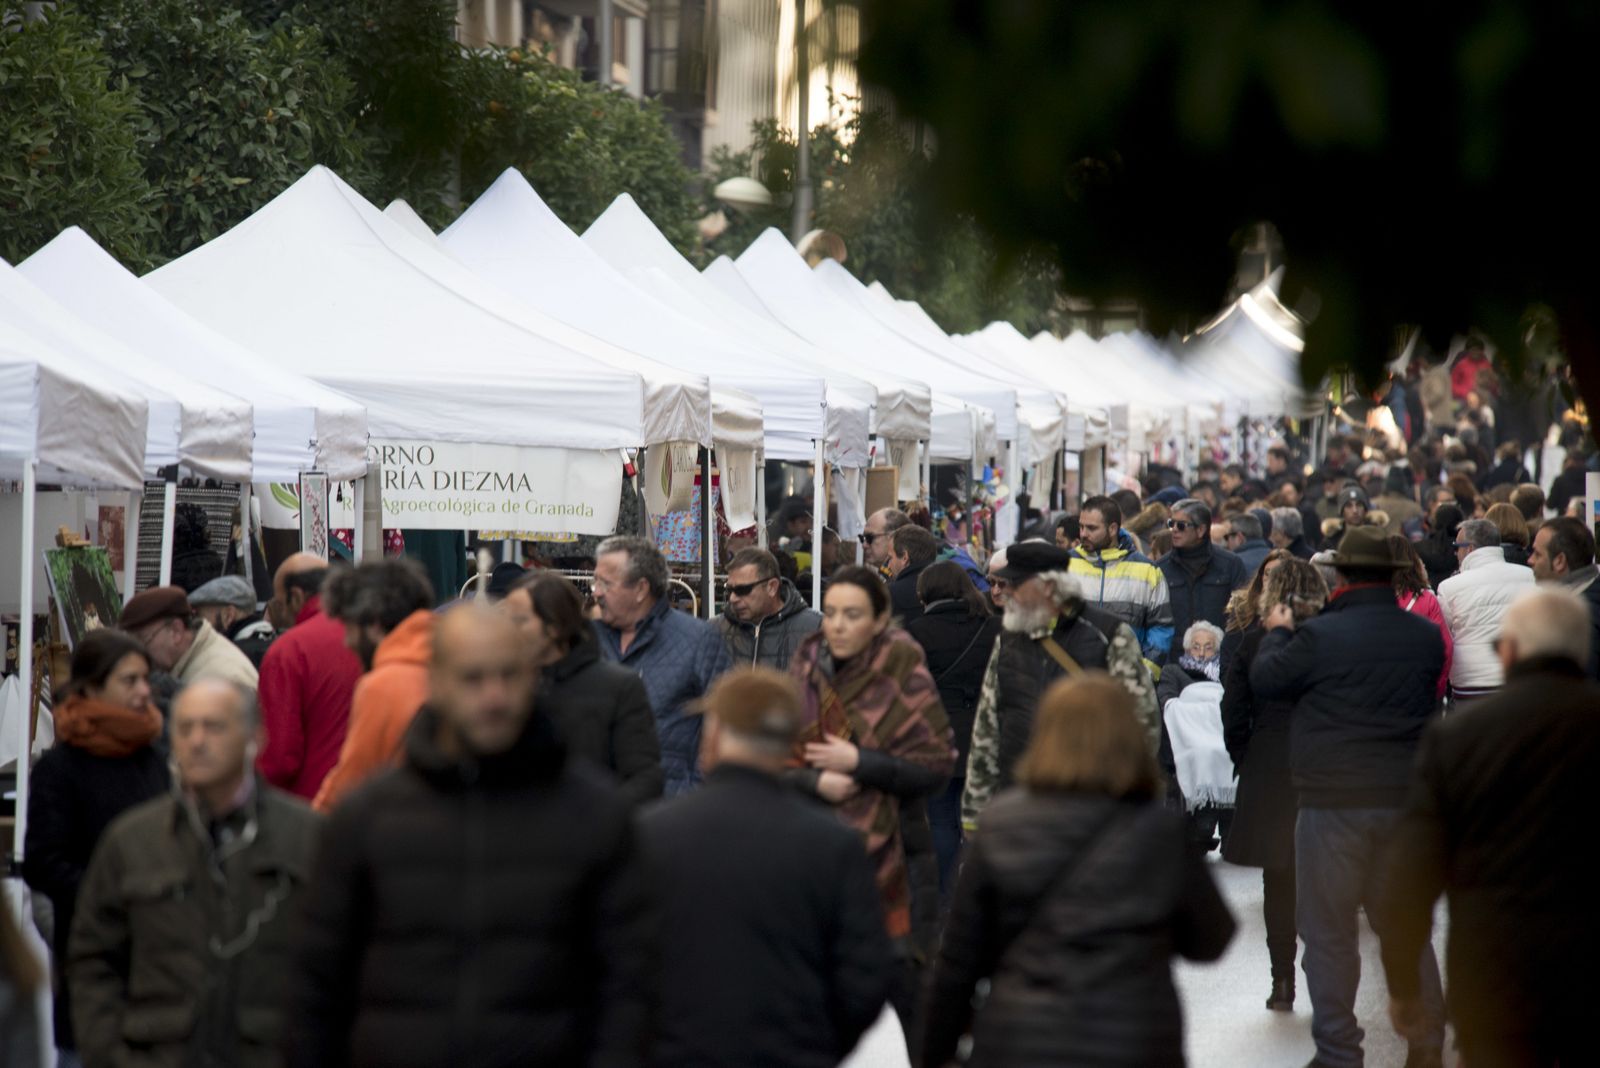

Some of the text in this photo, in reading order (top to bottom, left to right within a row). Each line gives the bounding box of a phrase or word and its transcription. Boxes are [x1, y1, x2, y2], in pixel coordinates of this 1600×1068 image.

[433, 470, 533, 493] DIEZMA
[381, 497, 594, 517] Agroecológica de Granada
